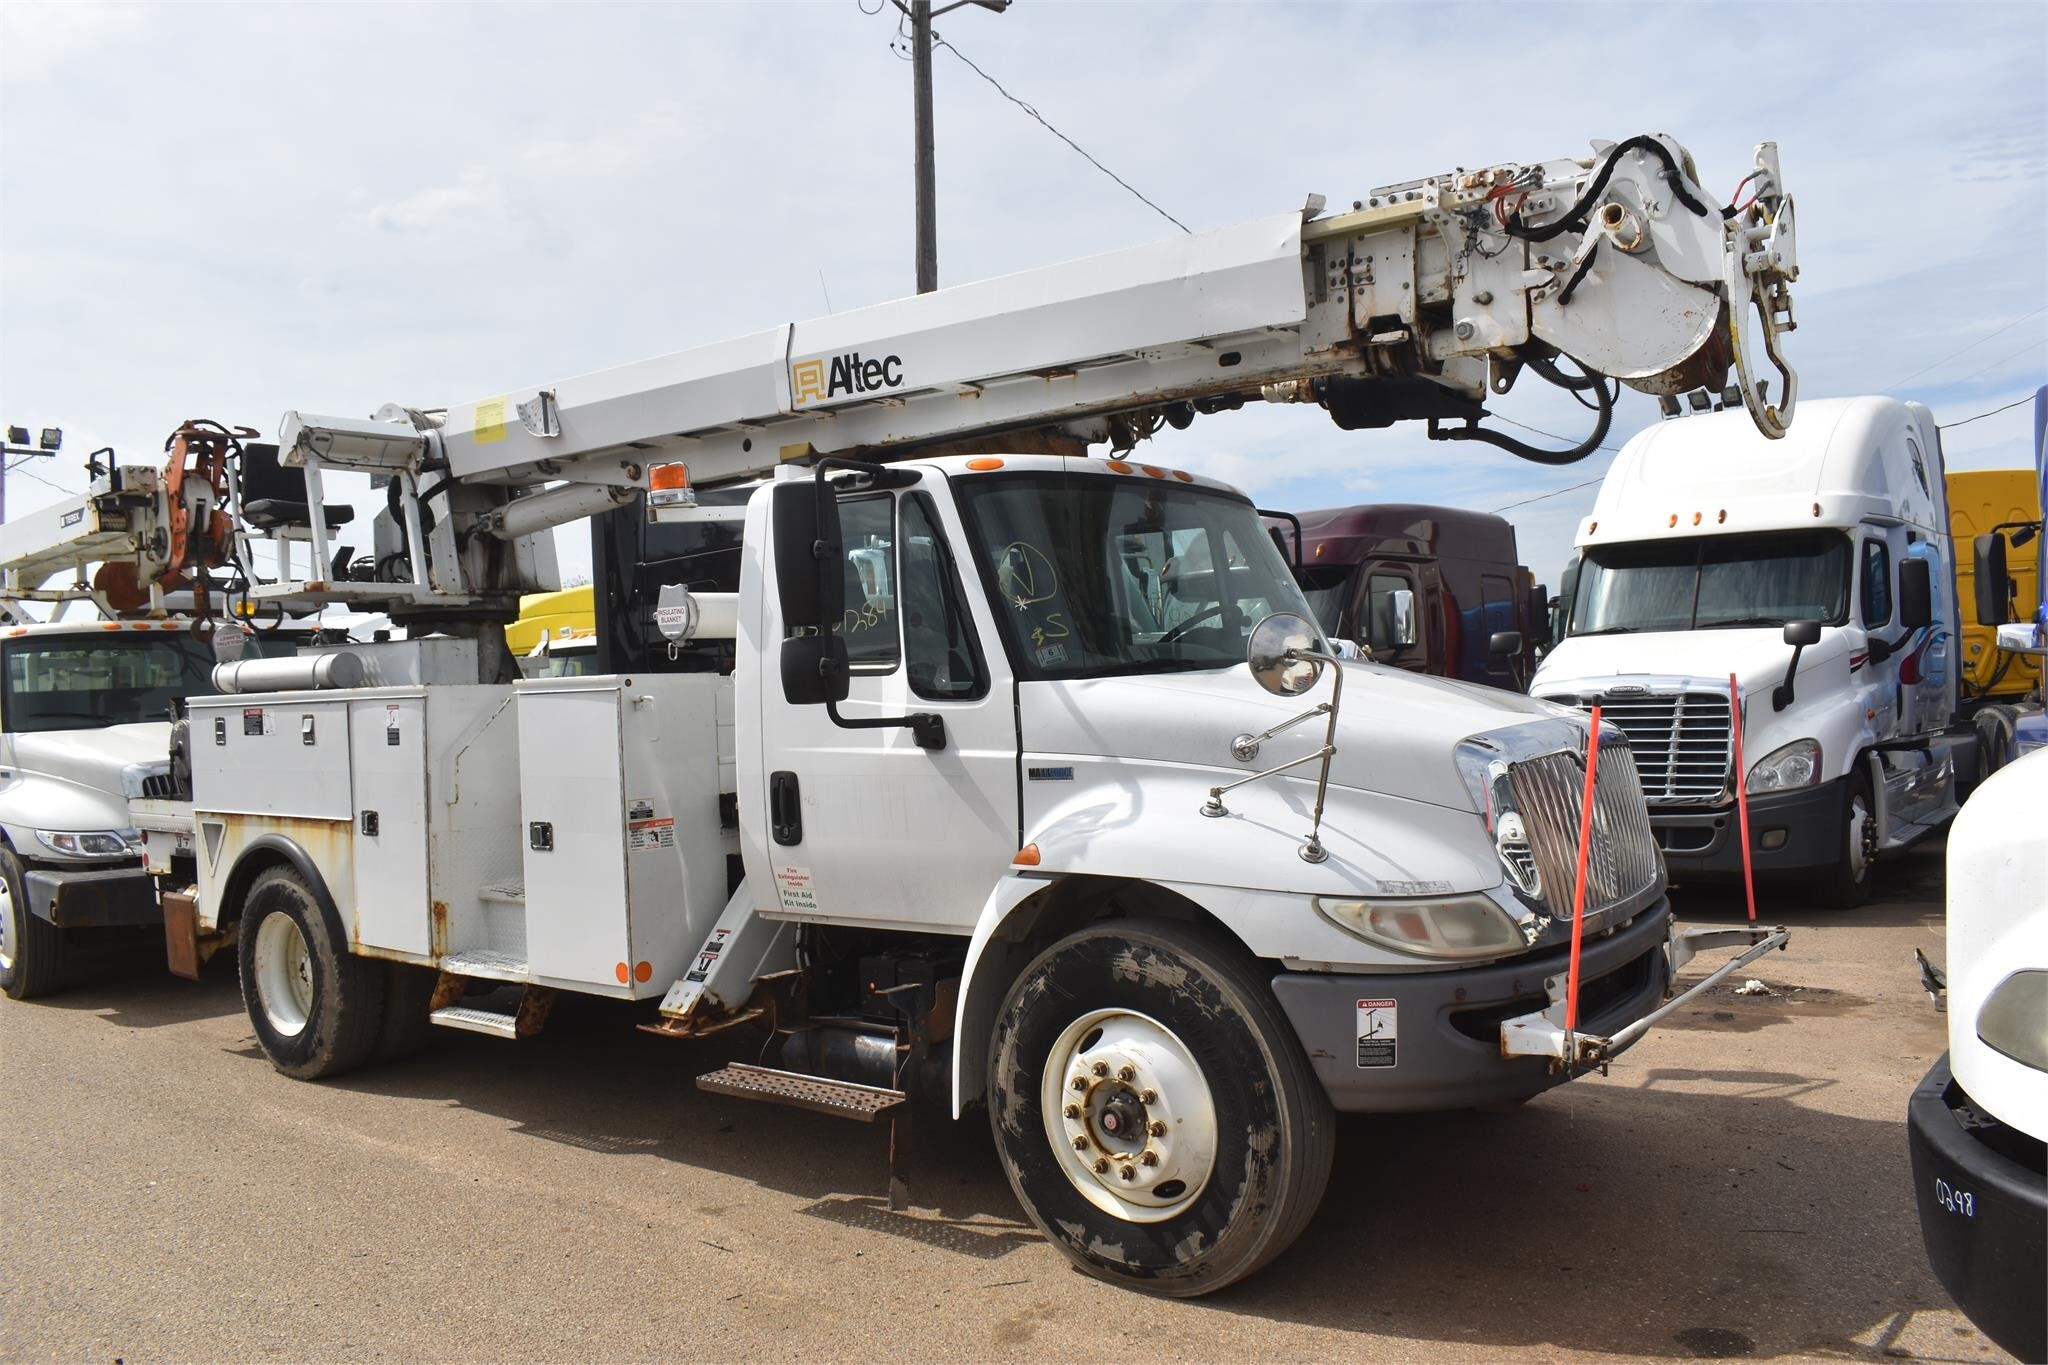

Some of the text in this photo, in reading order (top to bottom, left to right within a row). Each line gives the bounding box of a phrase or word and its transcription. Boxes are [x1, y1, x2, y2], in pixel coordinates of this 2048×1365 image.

[827, 352, 904, 398] Altec
[657, 607, 685, 616] INSULATING
[660, 615, 682, 624] BLANKET
[778, 873, 810, 881] Extinguisher
[784, 890, 813, 899] First Aid
[784, 899, 818, 909] Kit Inside
[1935, 1177, 1973, 1217] 0298
